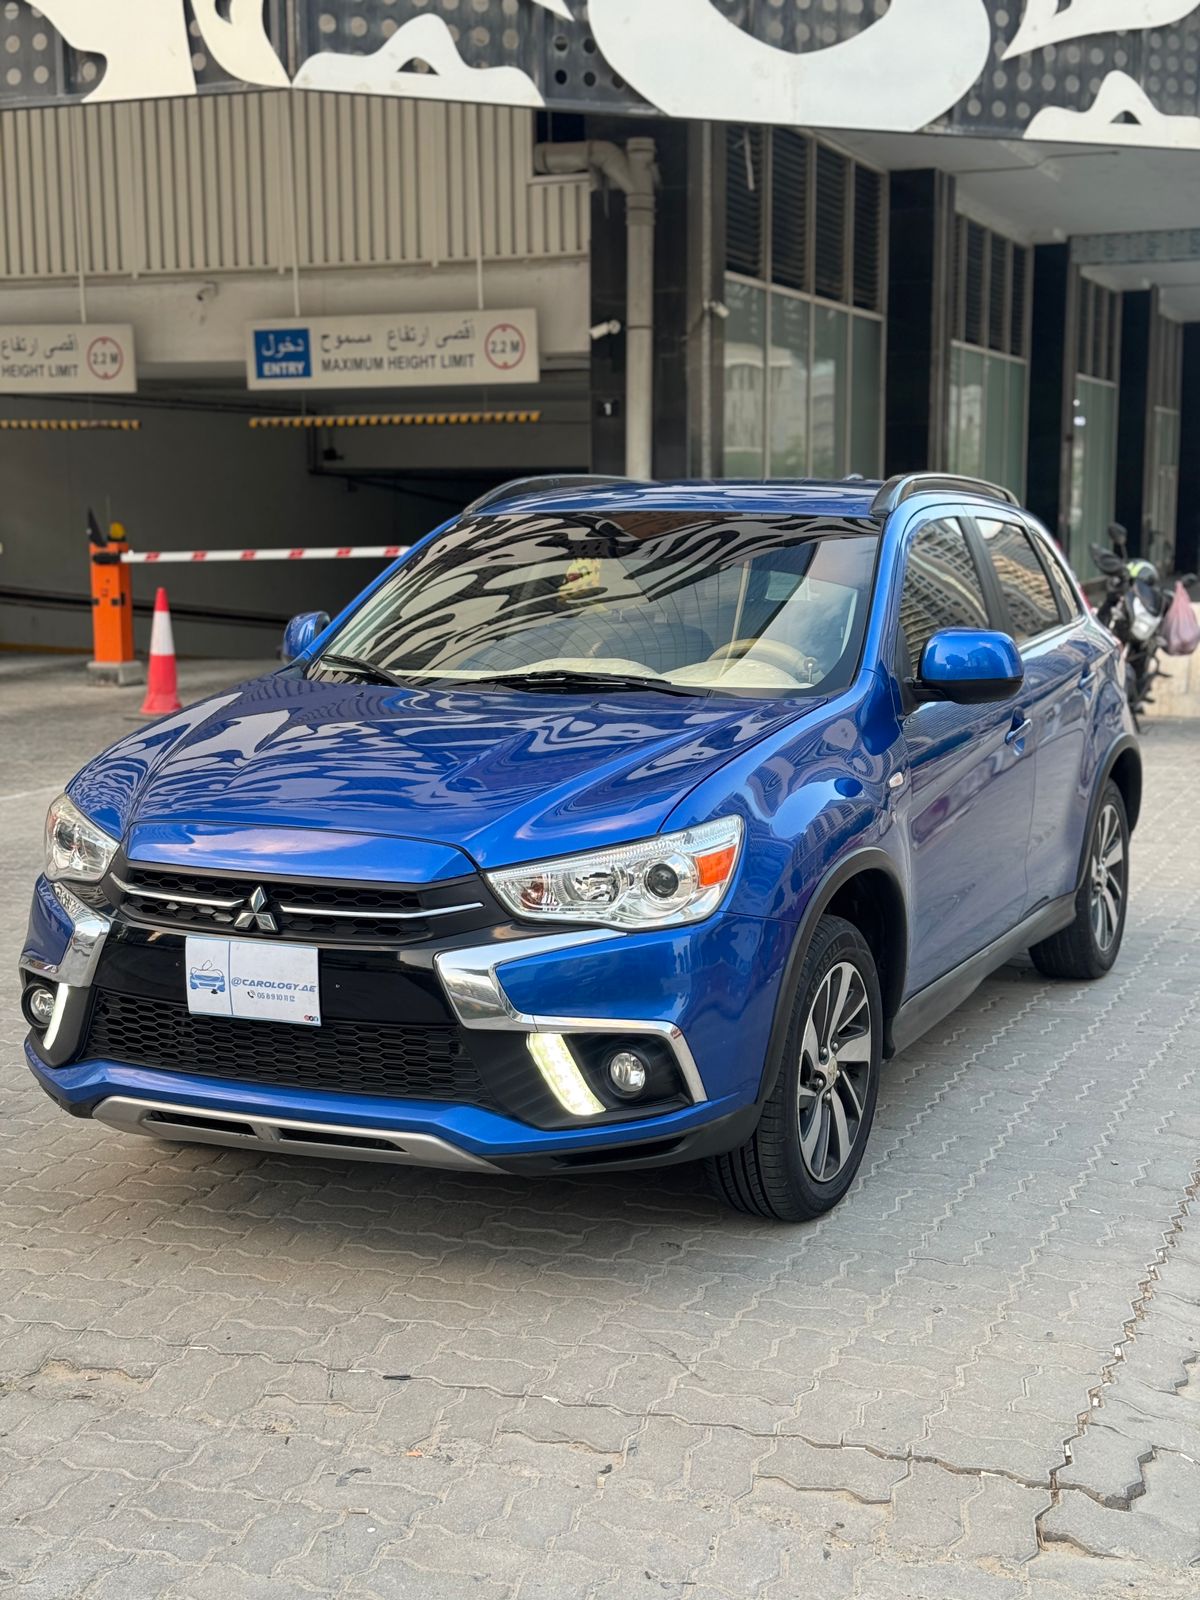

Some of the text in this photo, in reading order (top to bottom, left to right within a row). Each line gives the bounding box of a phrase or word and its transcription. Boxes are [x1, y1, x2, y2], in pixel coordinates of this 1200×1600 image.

[262, 333, 305, 358] دخول
[320, 333, 372, 353] مسموح
[387, 325, 429, 351] ارتفاع
[491, 340, 520, 354] 2.2 M
[93, 352, 119, 365] 2.2 M
[321, 354, 475, 371] MAXIMUM HEIGHT LIMIT
[1, 364, 79, 377] HEIGHT LIMIT
[263, 361, 305, 376] ENTRY
[232, 977, 316, 992] @CAROLOGY.AE
